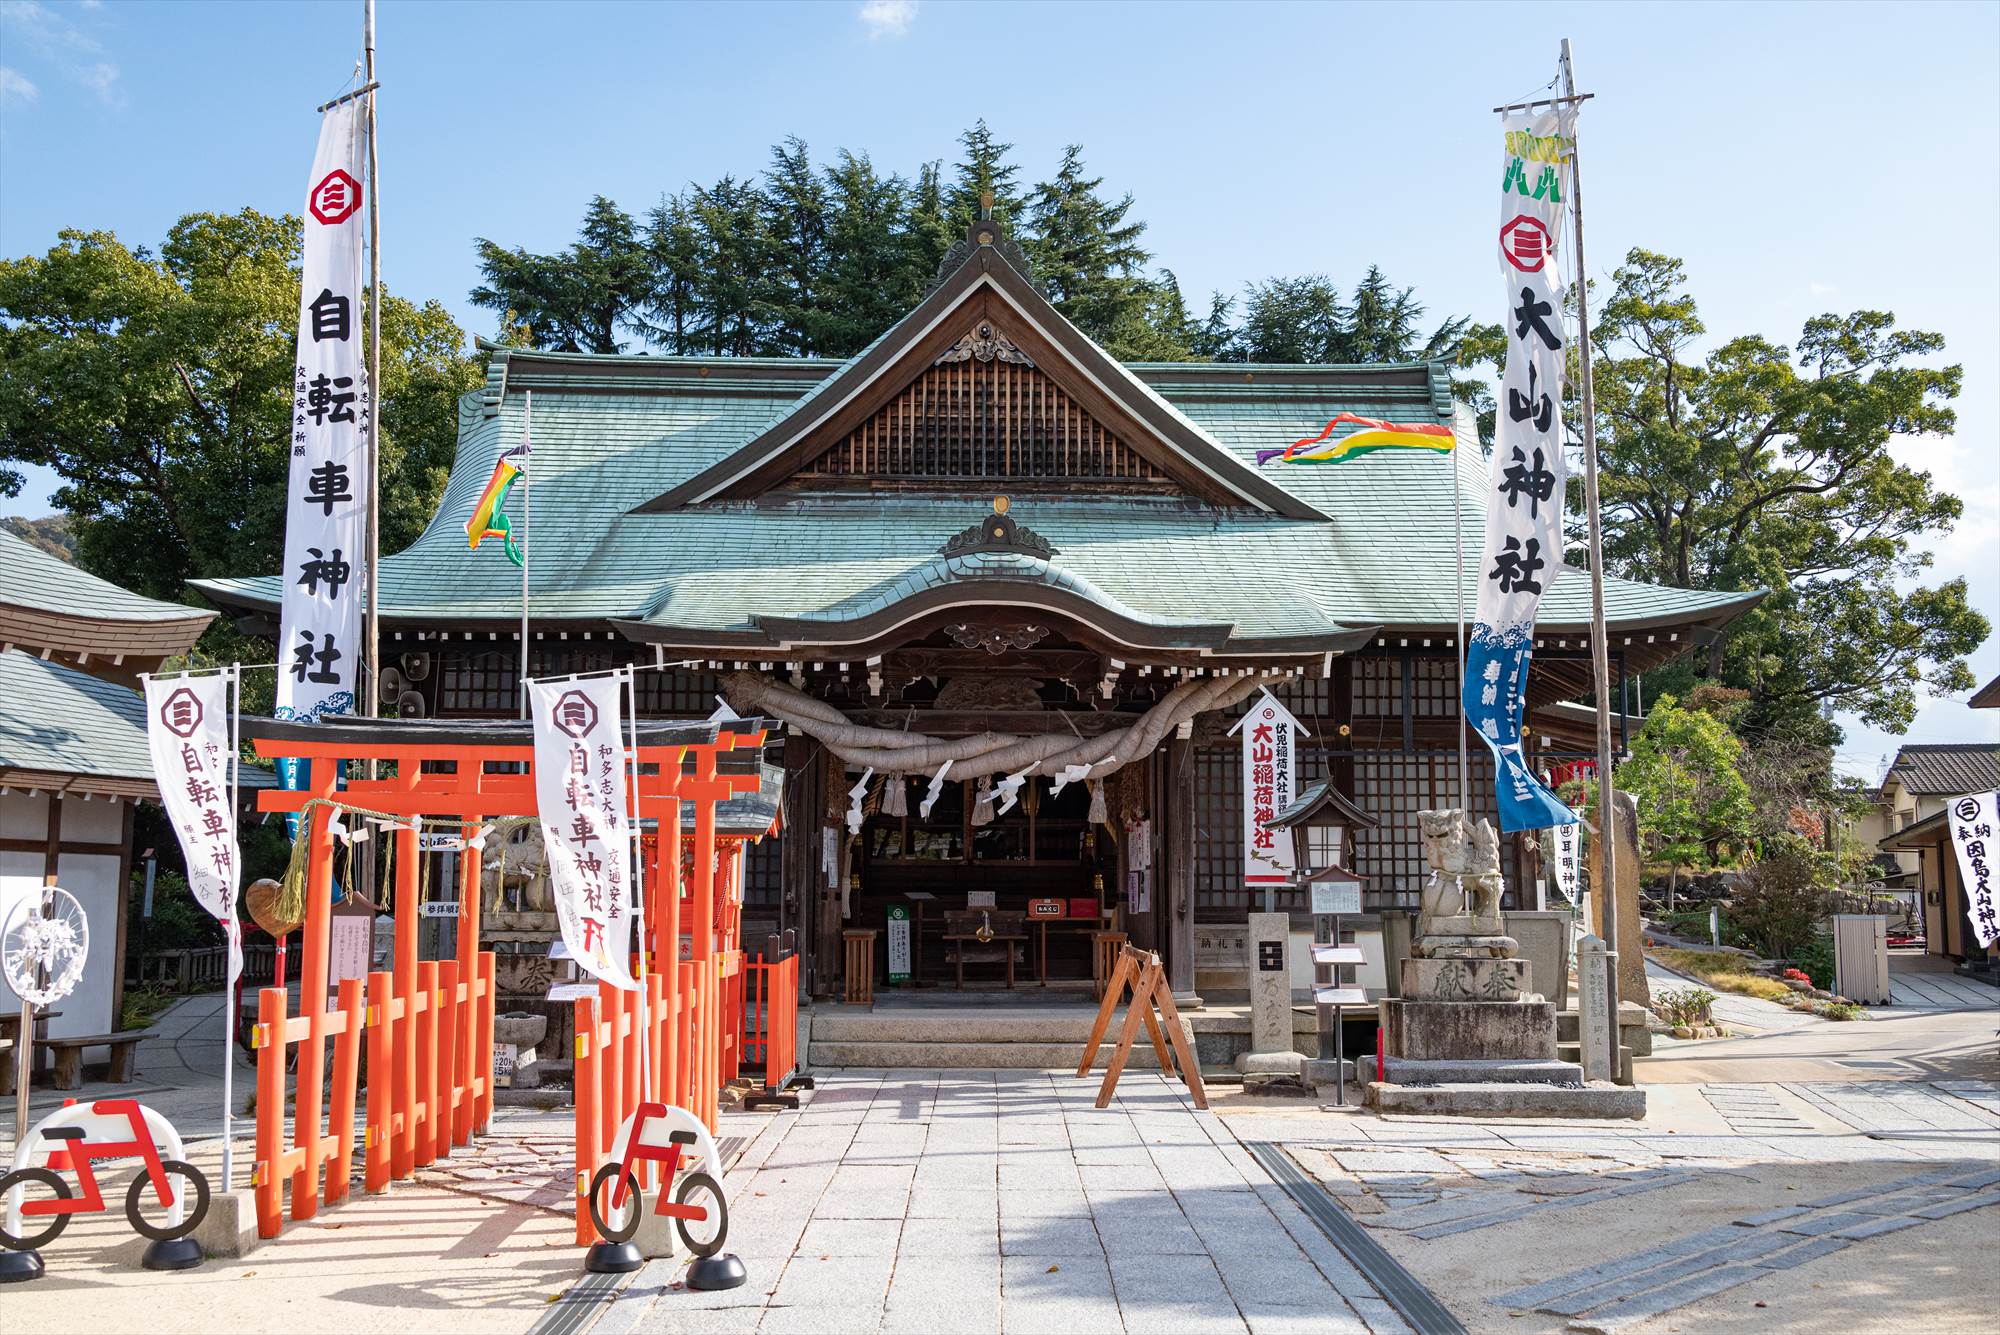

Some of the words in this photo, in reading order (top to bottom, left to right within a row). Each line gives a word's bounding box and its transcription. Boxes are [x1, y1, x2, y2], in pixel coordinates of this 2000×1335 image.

[294, 365, 306, 457] 交通安全祈願
[1489, 286, 1562, 597] 大山神社
[289, 288, 357, 684] 自転車神社
[598, 743, 617, 830] 和多志大神
[1252, 723, 1275, 848] 大山稲荷神社
[1276, 722, 1288, 793] 伏見稲荷大社
[565, 742, 602, 913] 自転車神社
[1561, 841, 1576, 898] 耳明神社
[1957, 822, 1991, 842] 奉納
[607, 849, 622, 919] 交通安全
[1967, 840, 2000, 940] 因島大山神社
